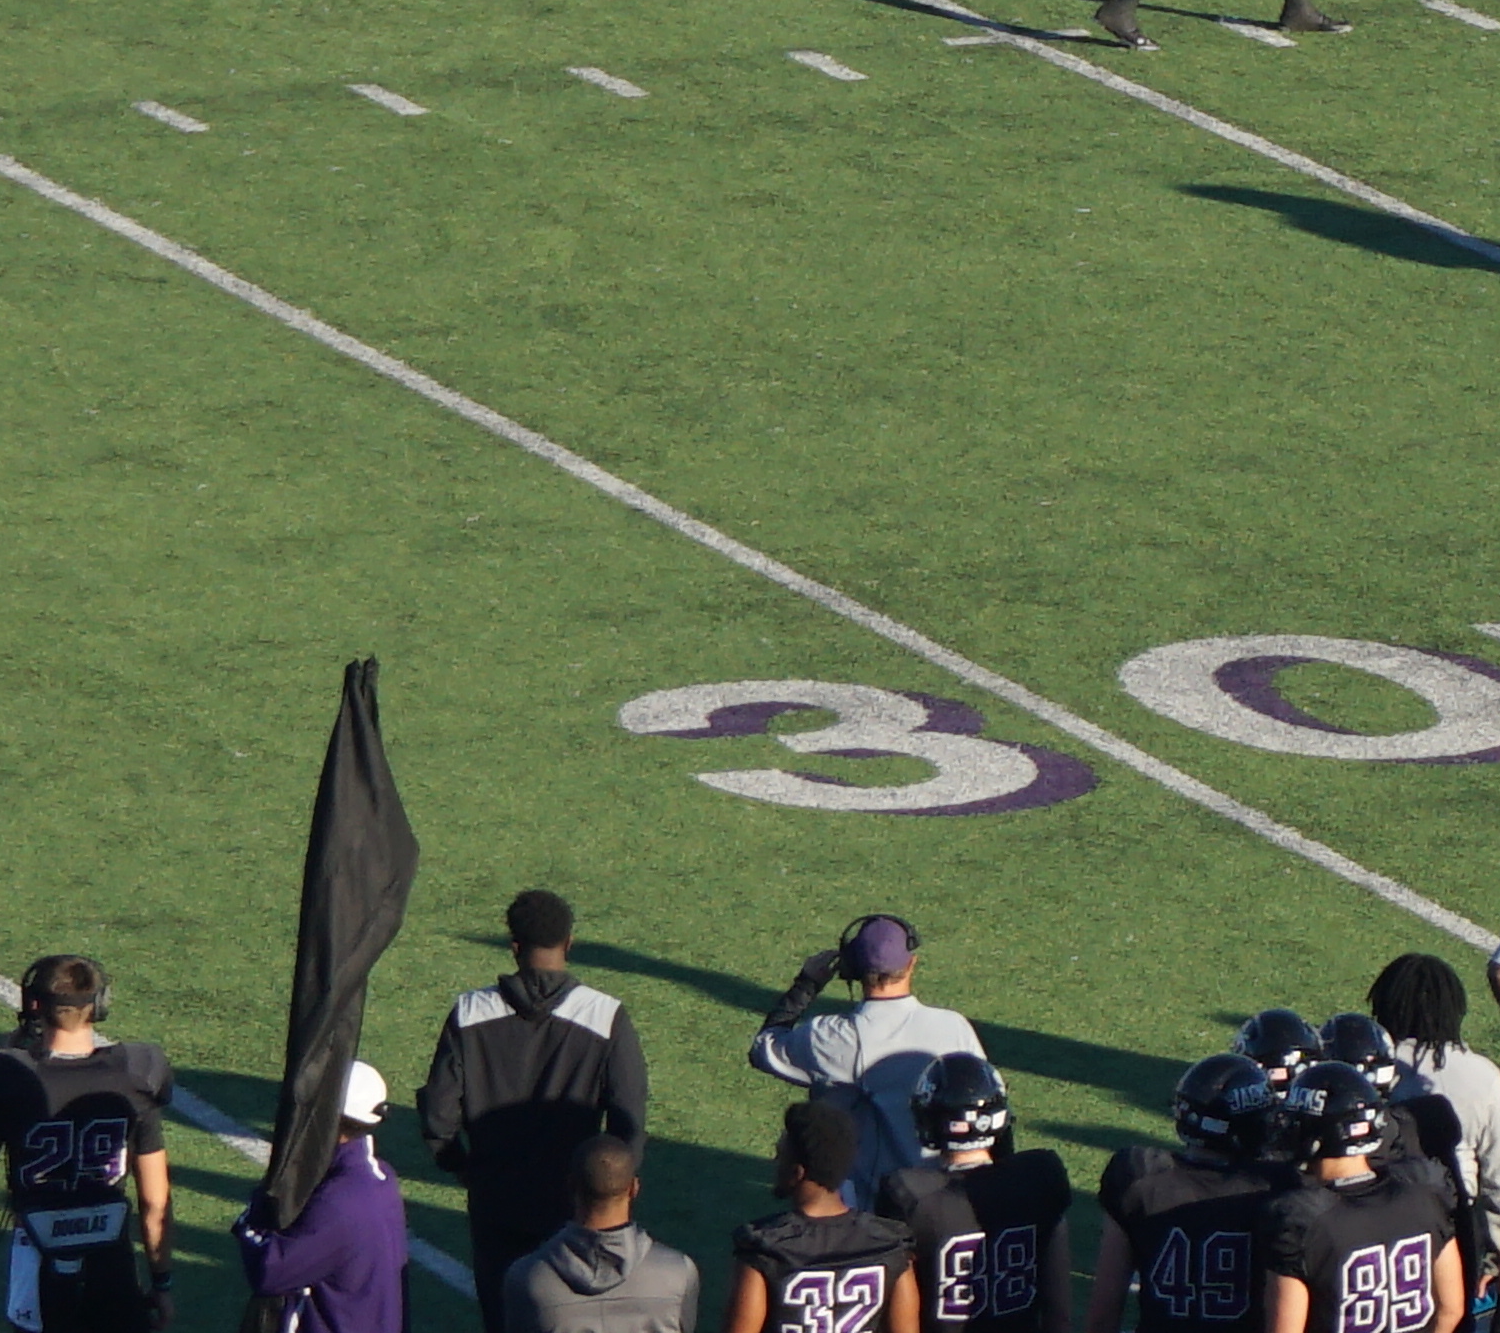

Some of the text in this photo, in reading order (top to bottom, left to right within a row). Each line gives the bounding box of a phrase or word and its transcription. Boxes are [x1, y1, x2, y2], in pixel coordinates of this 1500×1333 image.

[19, 1117, 129, 1191] 29
[782, 1264, 887, 1333] 32
[936, 1223, 1038, 1321] 88
[1149, 1226, 1252, 1320] 49
[1339, 1233, 1435, 1333] 89
